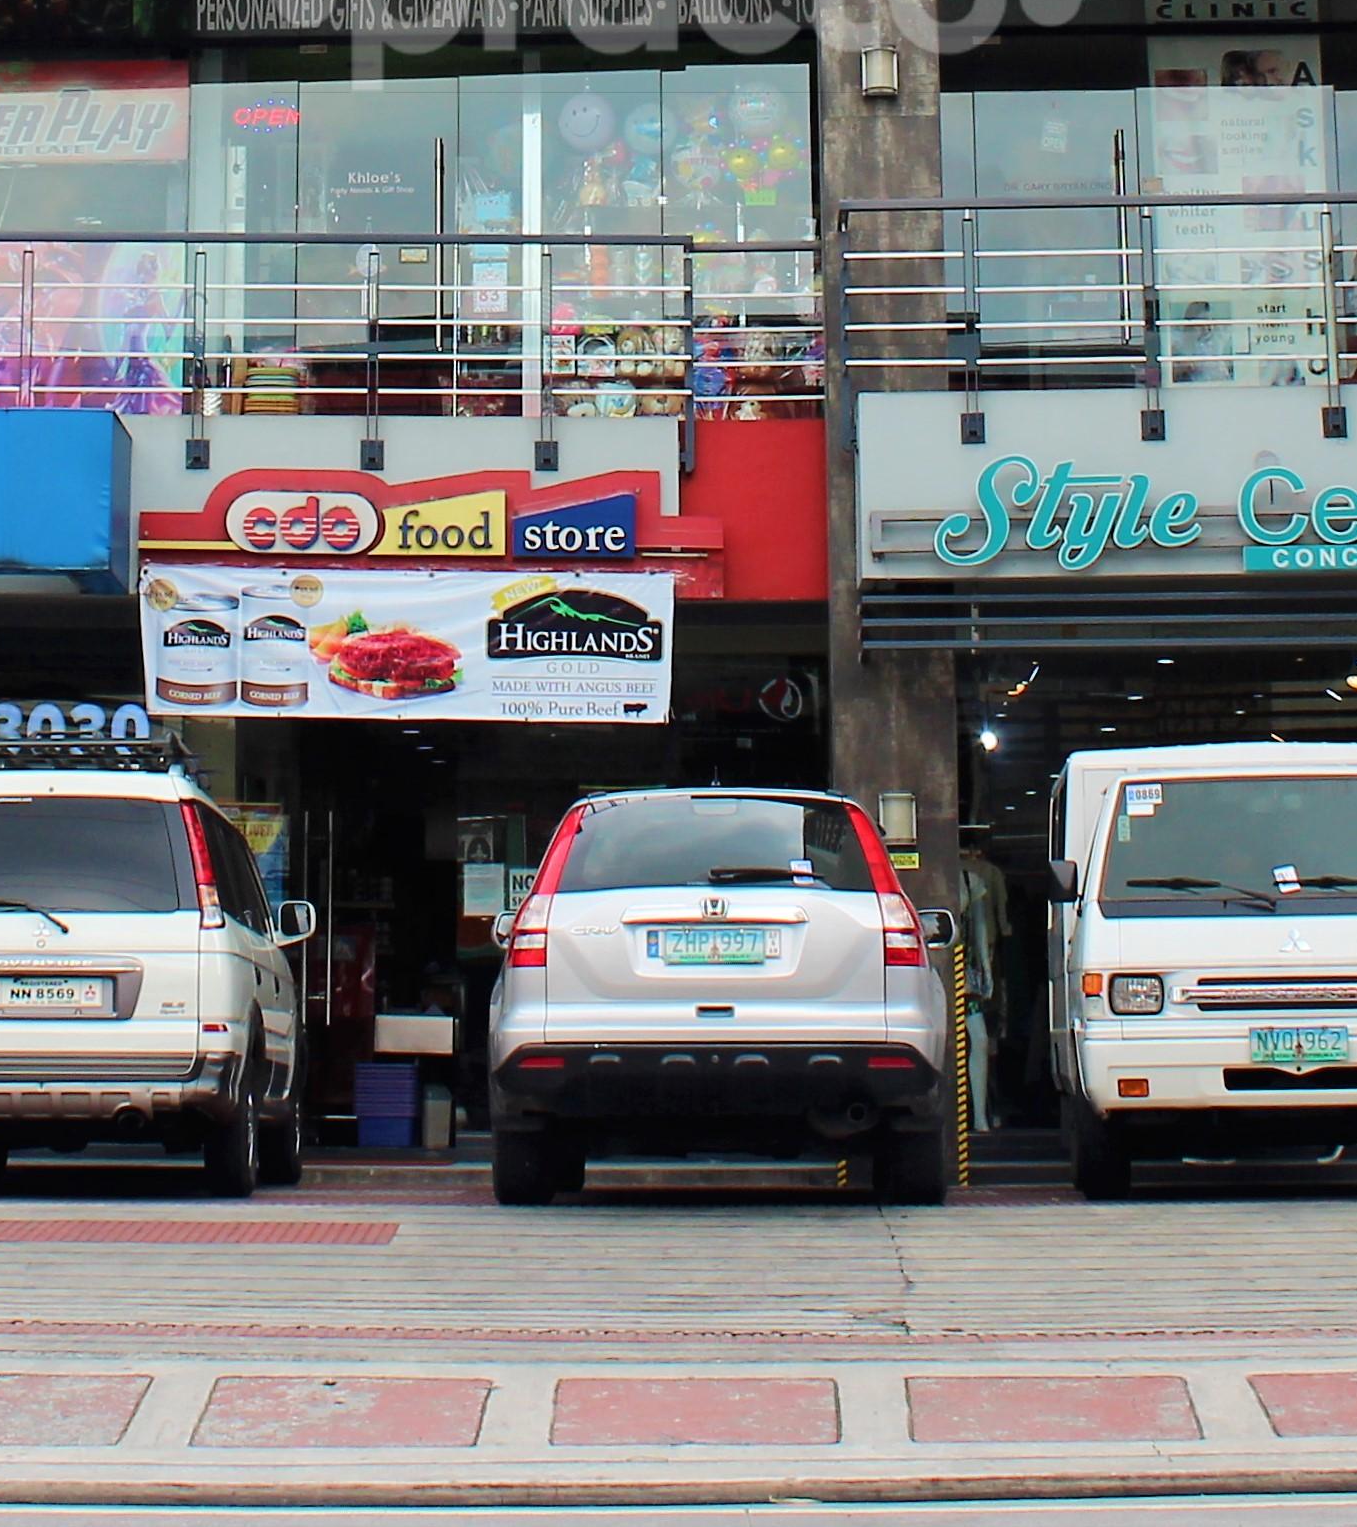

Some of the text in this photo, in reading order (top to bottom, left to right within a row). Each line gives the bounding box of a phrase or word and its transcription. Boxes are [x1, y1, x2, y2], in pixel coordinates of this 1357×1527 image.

[1156, 1, 1307, 19] CLINIC
[233, 107, 301, 126] OPEN
[348, 171, 401, 184] Khloe's
[1175, 223, 1216, 235] teeth
[1256, 303, 1287, 314] start
[1255, 333, 1296, 345] young
[934, 454, 1203, 571] Style
[243, 495, 627, 552] cdo food store
[168, 630, 229, 646] HIGHLANDS
[247, 626, 306, 640] HIGHLANDS
[498, 622, 654, 653] HIGHLANDS
[546, 661, 601, 674] GOLD
[492, 681, 657, 694] MADE WITH ANGUS BEEF
[500, 701, 621, 716] 100% Pure Beef
[672, 932, 709, 953] ZHP
[720, 932, 758, 952] 997
[10, 988, 75, 1000] NN 8569
[1304, 1031, 1342, 1051] 962
